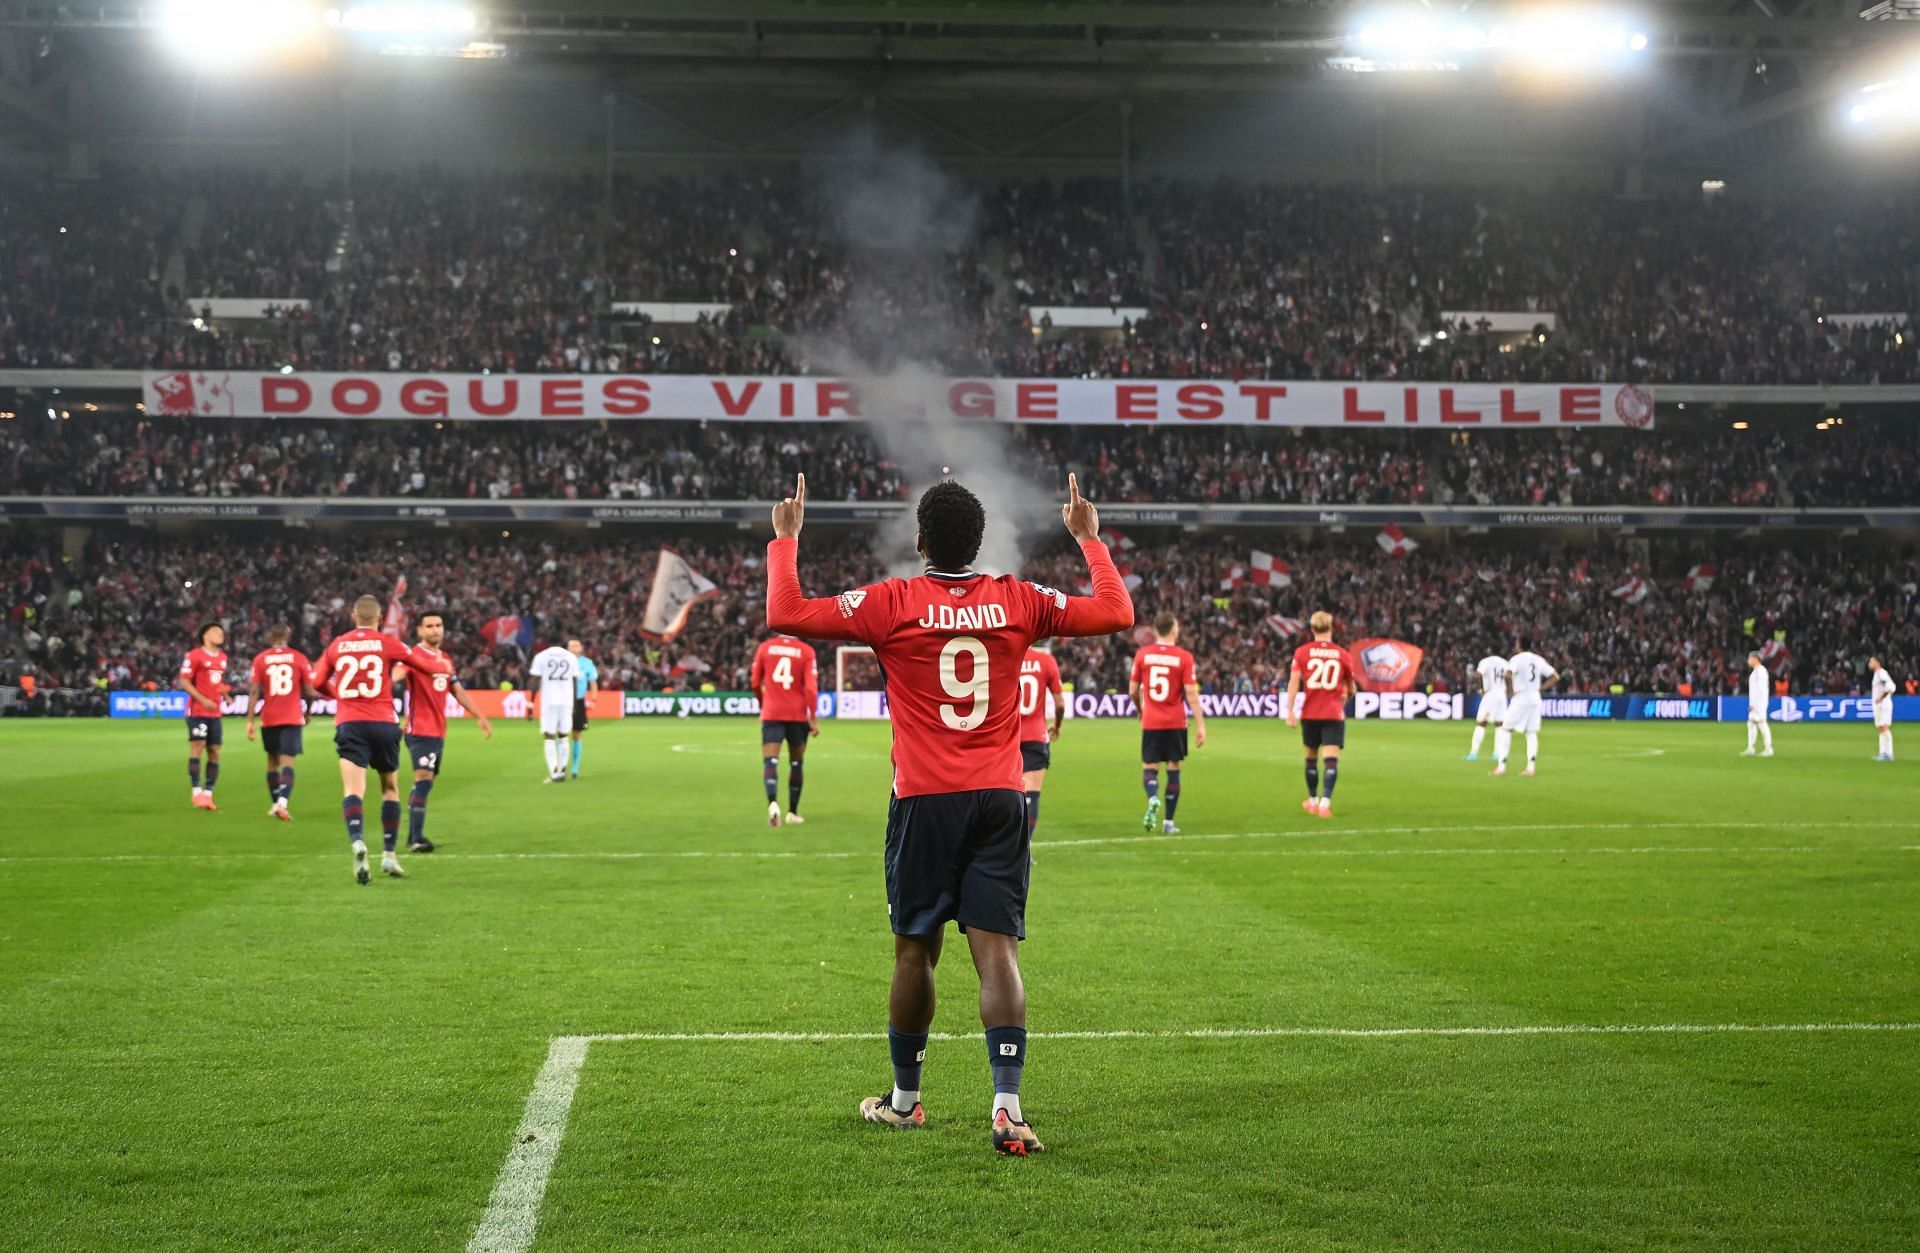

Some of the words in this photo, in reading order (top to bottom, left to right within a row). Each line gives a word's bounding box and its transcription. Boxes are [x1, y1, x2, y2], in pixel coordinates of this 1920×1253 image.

[260, 378, 652, 417] DOGUES
[711, 381, 1059, 420] VIRGE
[1115, 384, 1287, 421] EST
[1343, 387, 1601, 424] LILLE
[157, 505, 216, 515] CHAMPIONS
[220, 505, 259, 516] LEAGUE
[592, 508, 619, 518] UEFA
[623, 508, 681, 518] CHAMPIONS
[684, 509, 723, 518] LEAGUE
[1100, 511, 1138, 521] MPIONS
[1140, 512, 1178, 521] LEAGUE
[1527, 514, 1584, 524] CHAMPIONS
[1587, 515, 1624, 524] LEAGUE
[918, 603, 1007, 630] J.DAVID
[265, 663, 294, 697] 18
[335, 654, 384, 699] 23
[547, 659, 570, 681] 22
[772, 656, 795, 691] 4
[1306, 658, 1341, 692] 20
[1528, 663, 1536, 683] 3
[938, 635, 990, 731] 9
[1148, 665, 1170, 703] 5
[115, 696, 185, 712] RECYCLE
[625, 696, 675, 714] now
[677, 696, 721, 719] you
[1075, 694, 1138, 718] QATA
[1184, 694, 1280, 717] RWAYS
[1355, 692, 1464, 720] PEPSI
[1588, 699, 1612, 718] ALL
[1808, 699, 1874, 719] PS5
